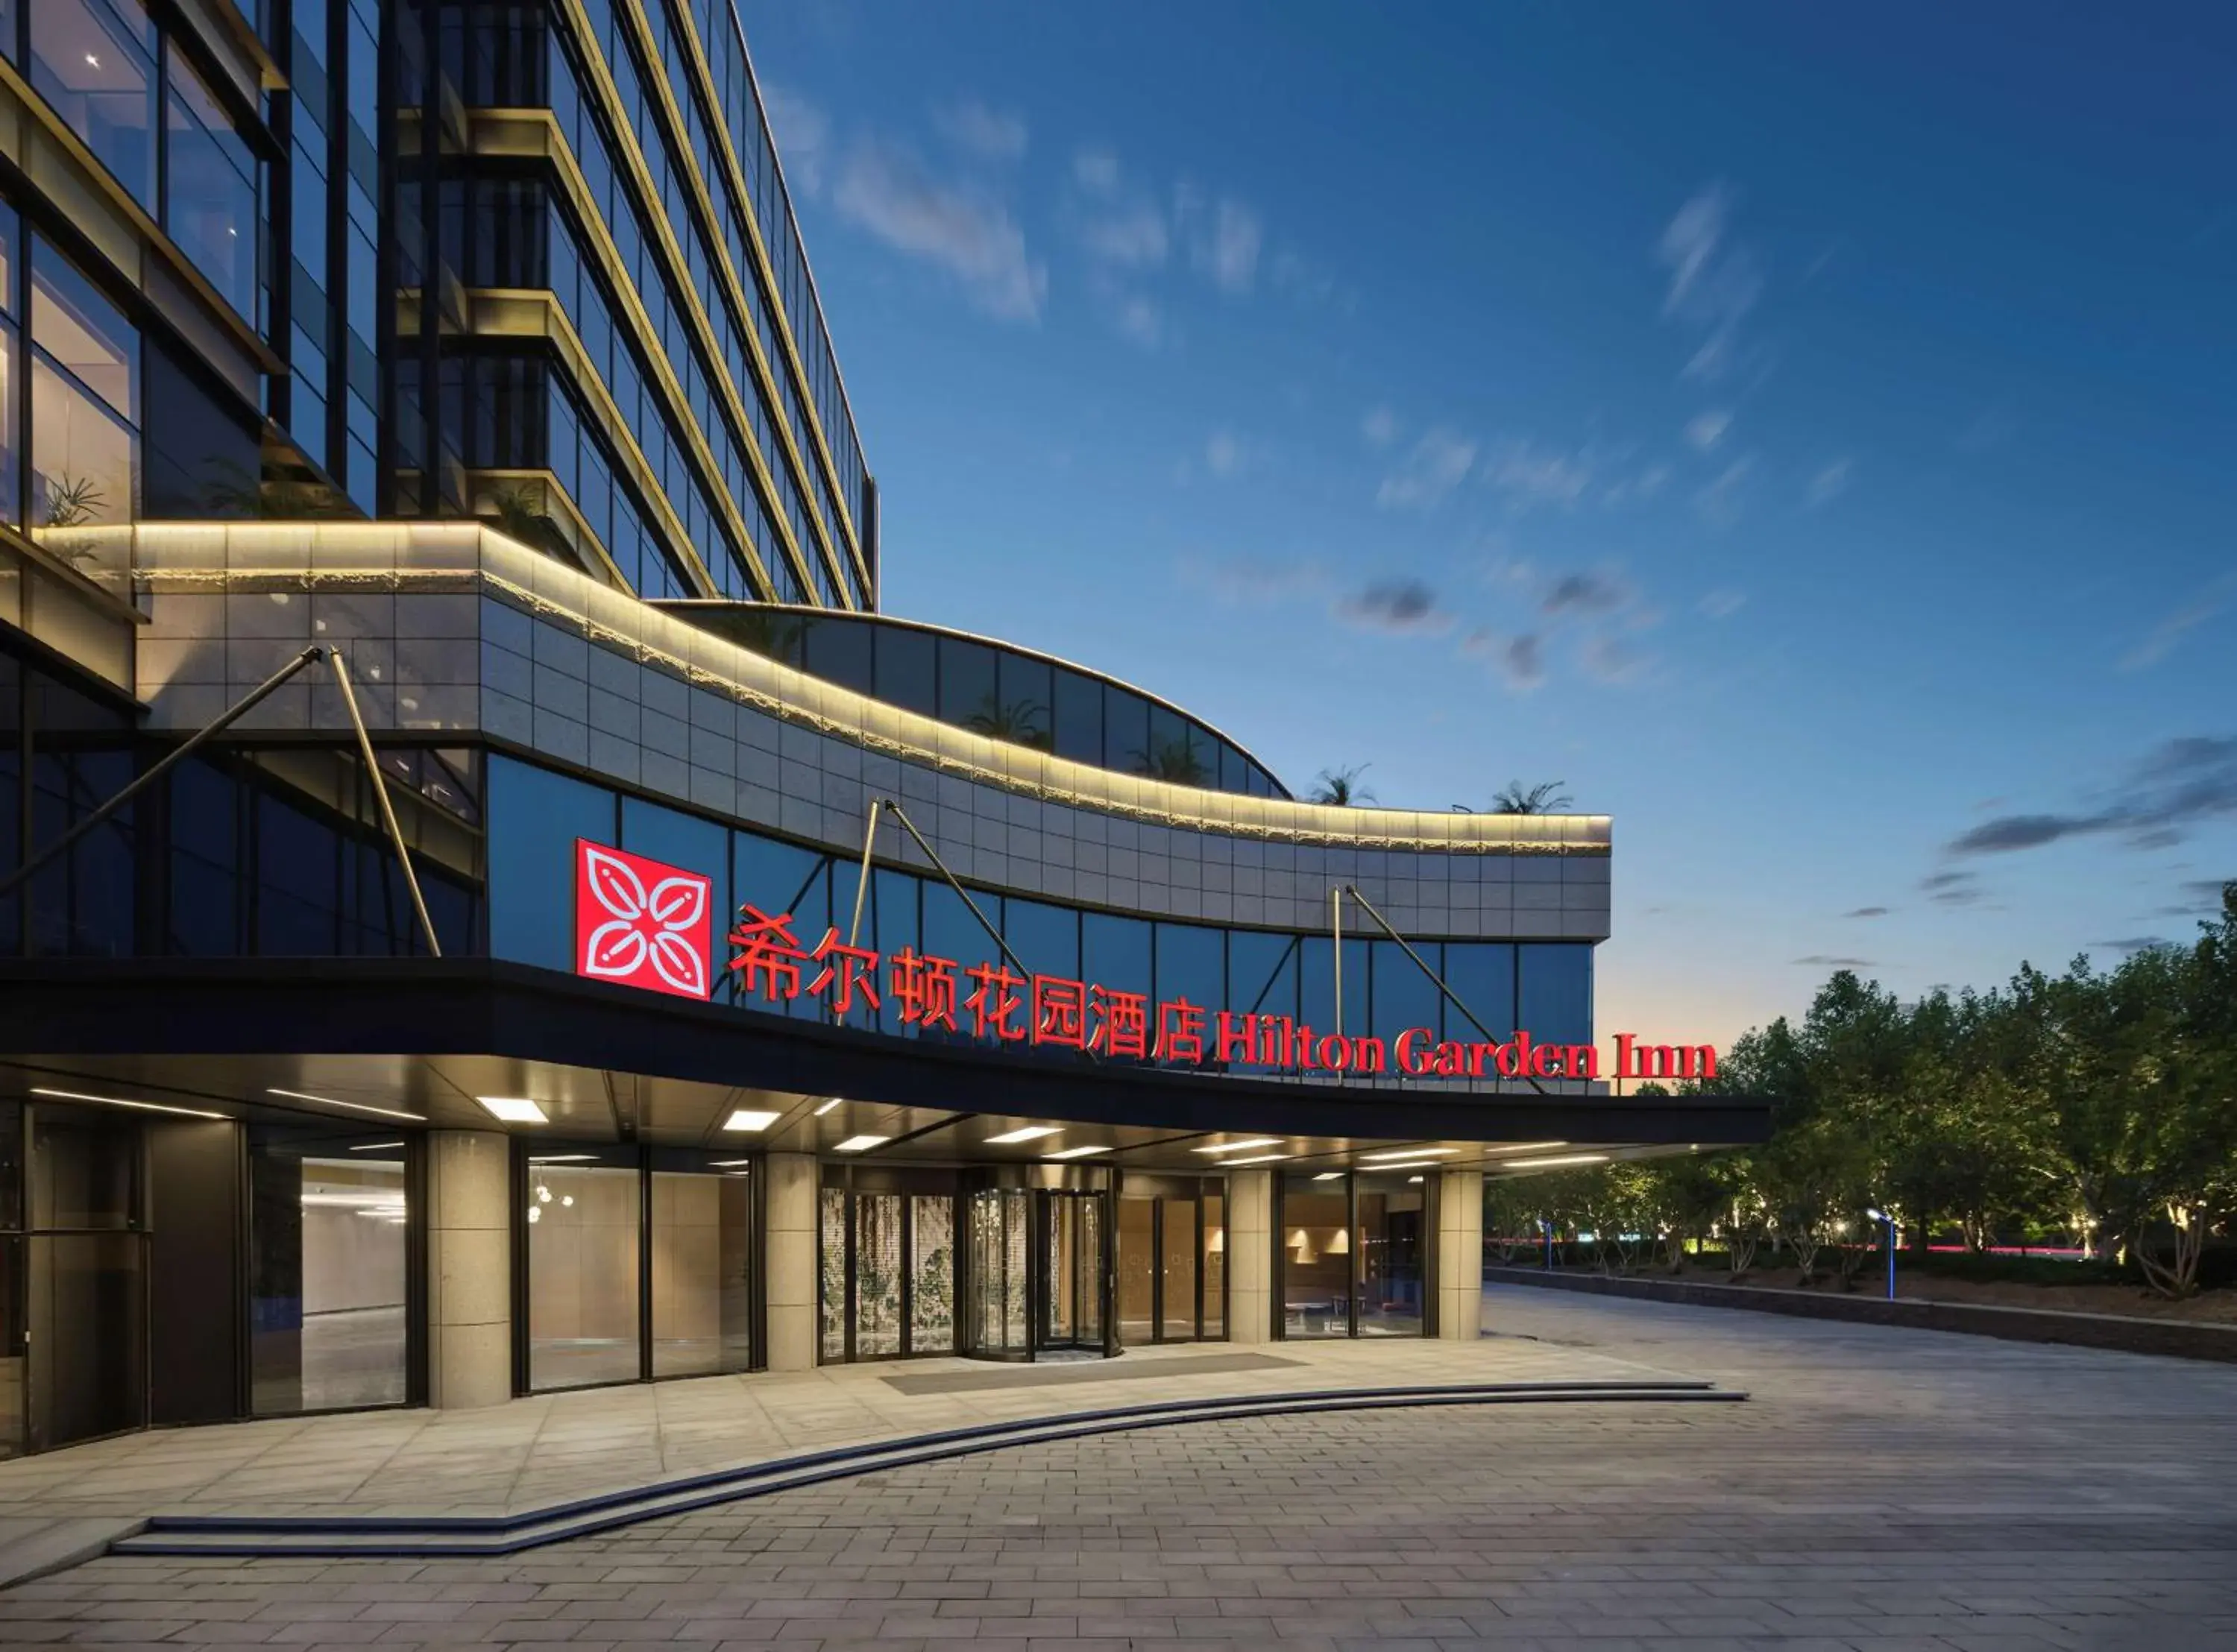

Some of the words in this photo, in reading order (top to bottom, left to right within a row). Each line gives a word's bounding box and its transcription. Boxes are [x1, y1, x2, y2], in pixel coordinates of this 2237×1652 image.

[728, 903, 1206, 1067] 希尔顿花园酒店
[1215, 1011, 1385, 1074] Hilton
[1395, 1028, 1601, 1080] Garden
[1614, 1032, 1719, 1080] Inn
